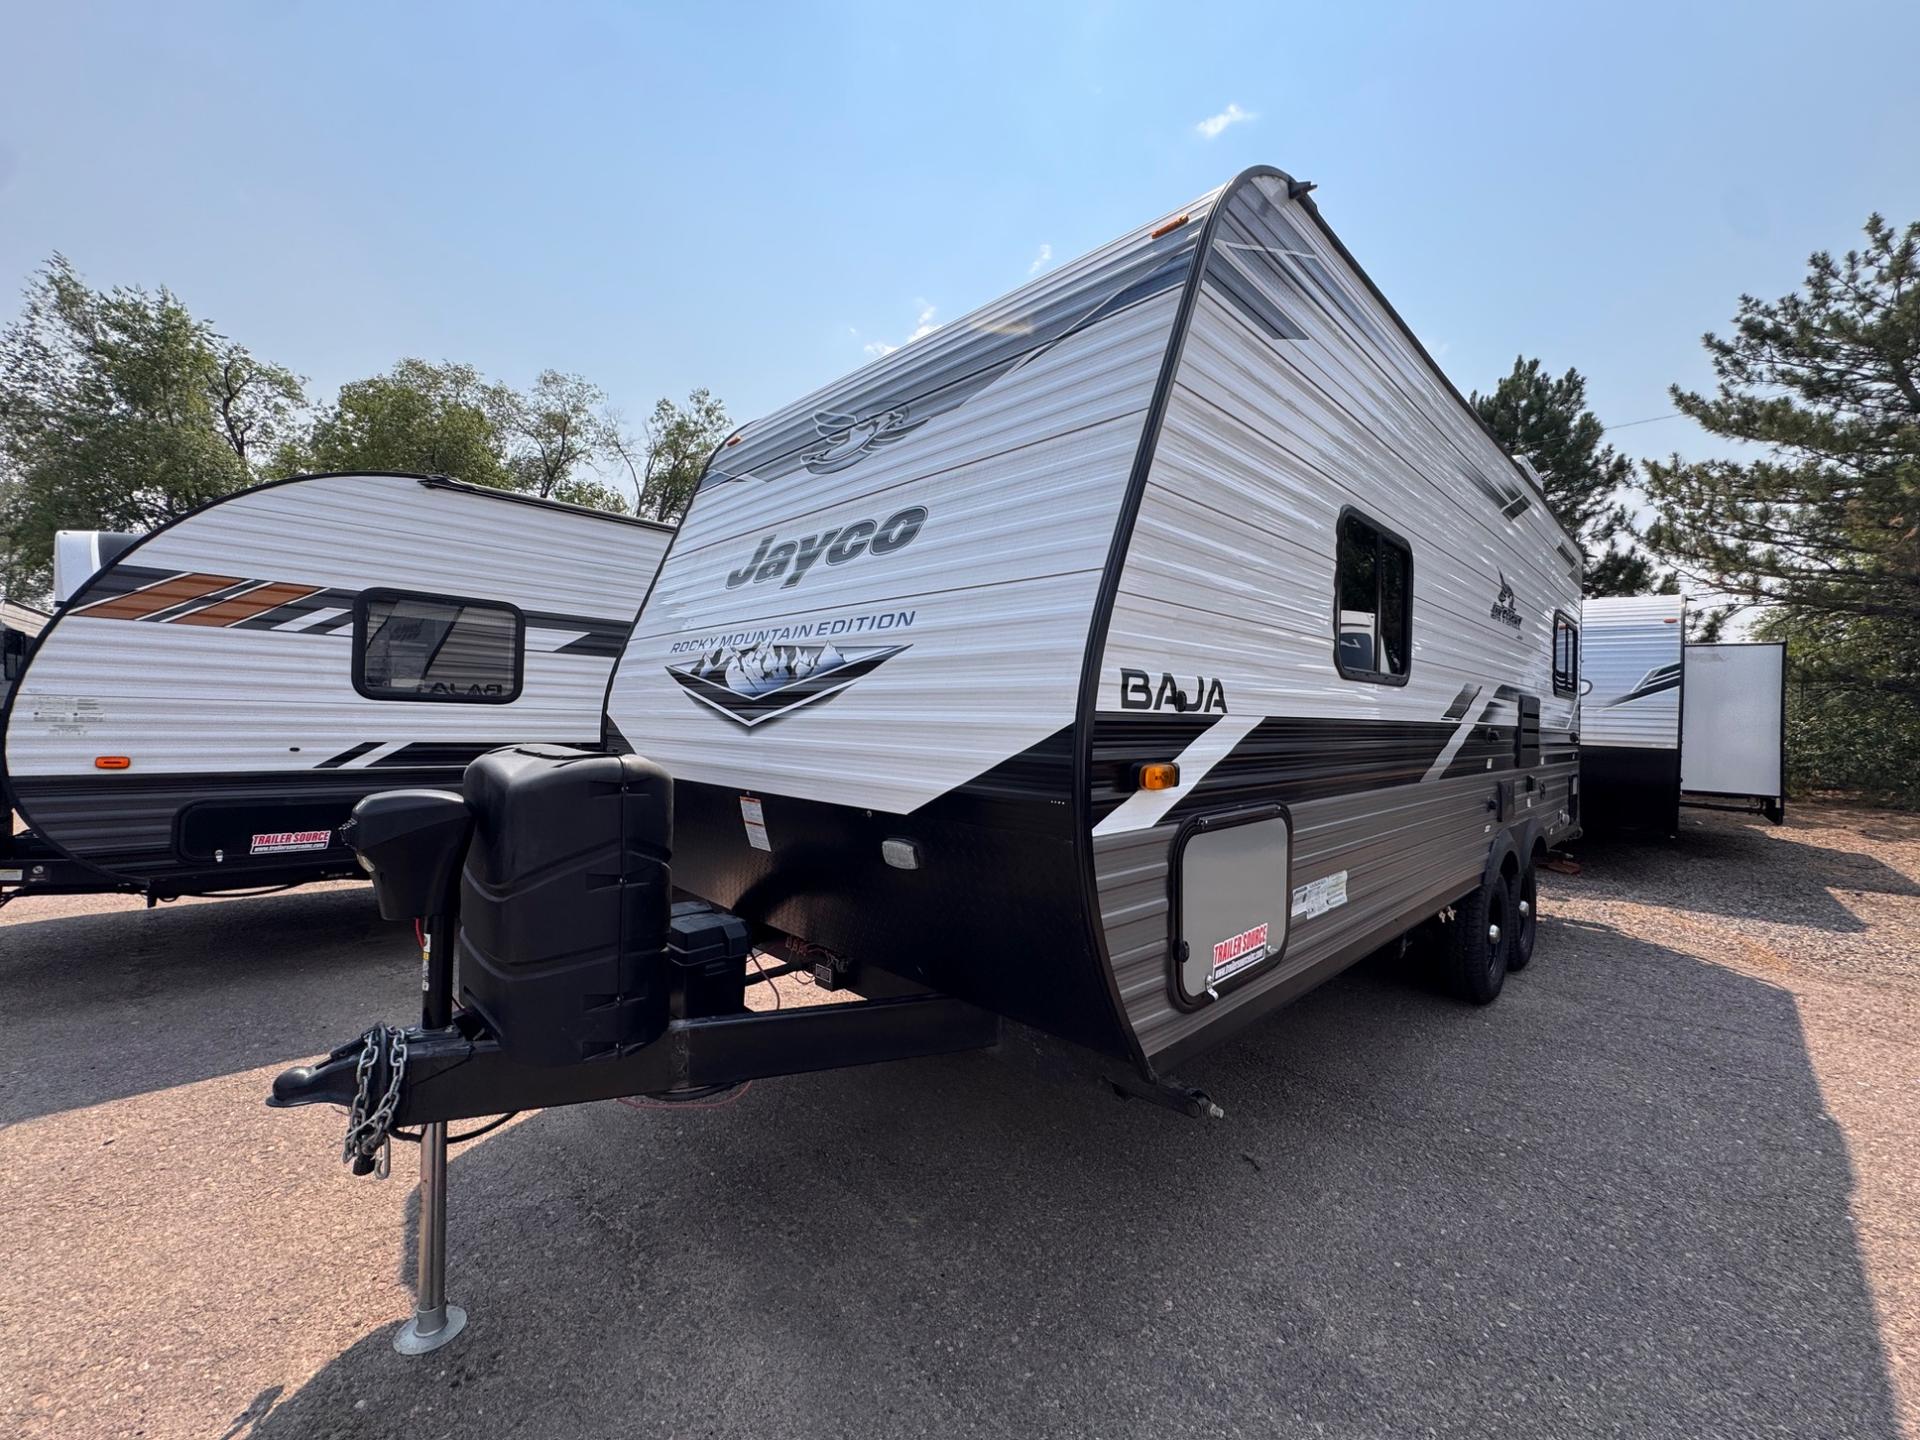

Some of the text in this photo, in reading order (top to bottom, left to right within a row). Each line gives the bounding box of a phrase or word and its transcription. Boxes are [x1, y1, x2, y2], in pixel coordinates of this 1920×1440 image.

[725, 505, 929, 590] Jayco
[670, 611, 917, 654] ROCKY MOUNTAIN EDITION
[1120, 668, 1228, 714] BAJA
[253, 831, 329, 845] TRAILER SOURCE
[1214, 935, 1242, 966] TRAILER
[1243, 925, 1267, 952] SOURCE
